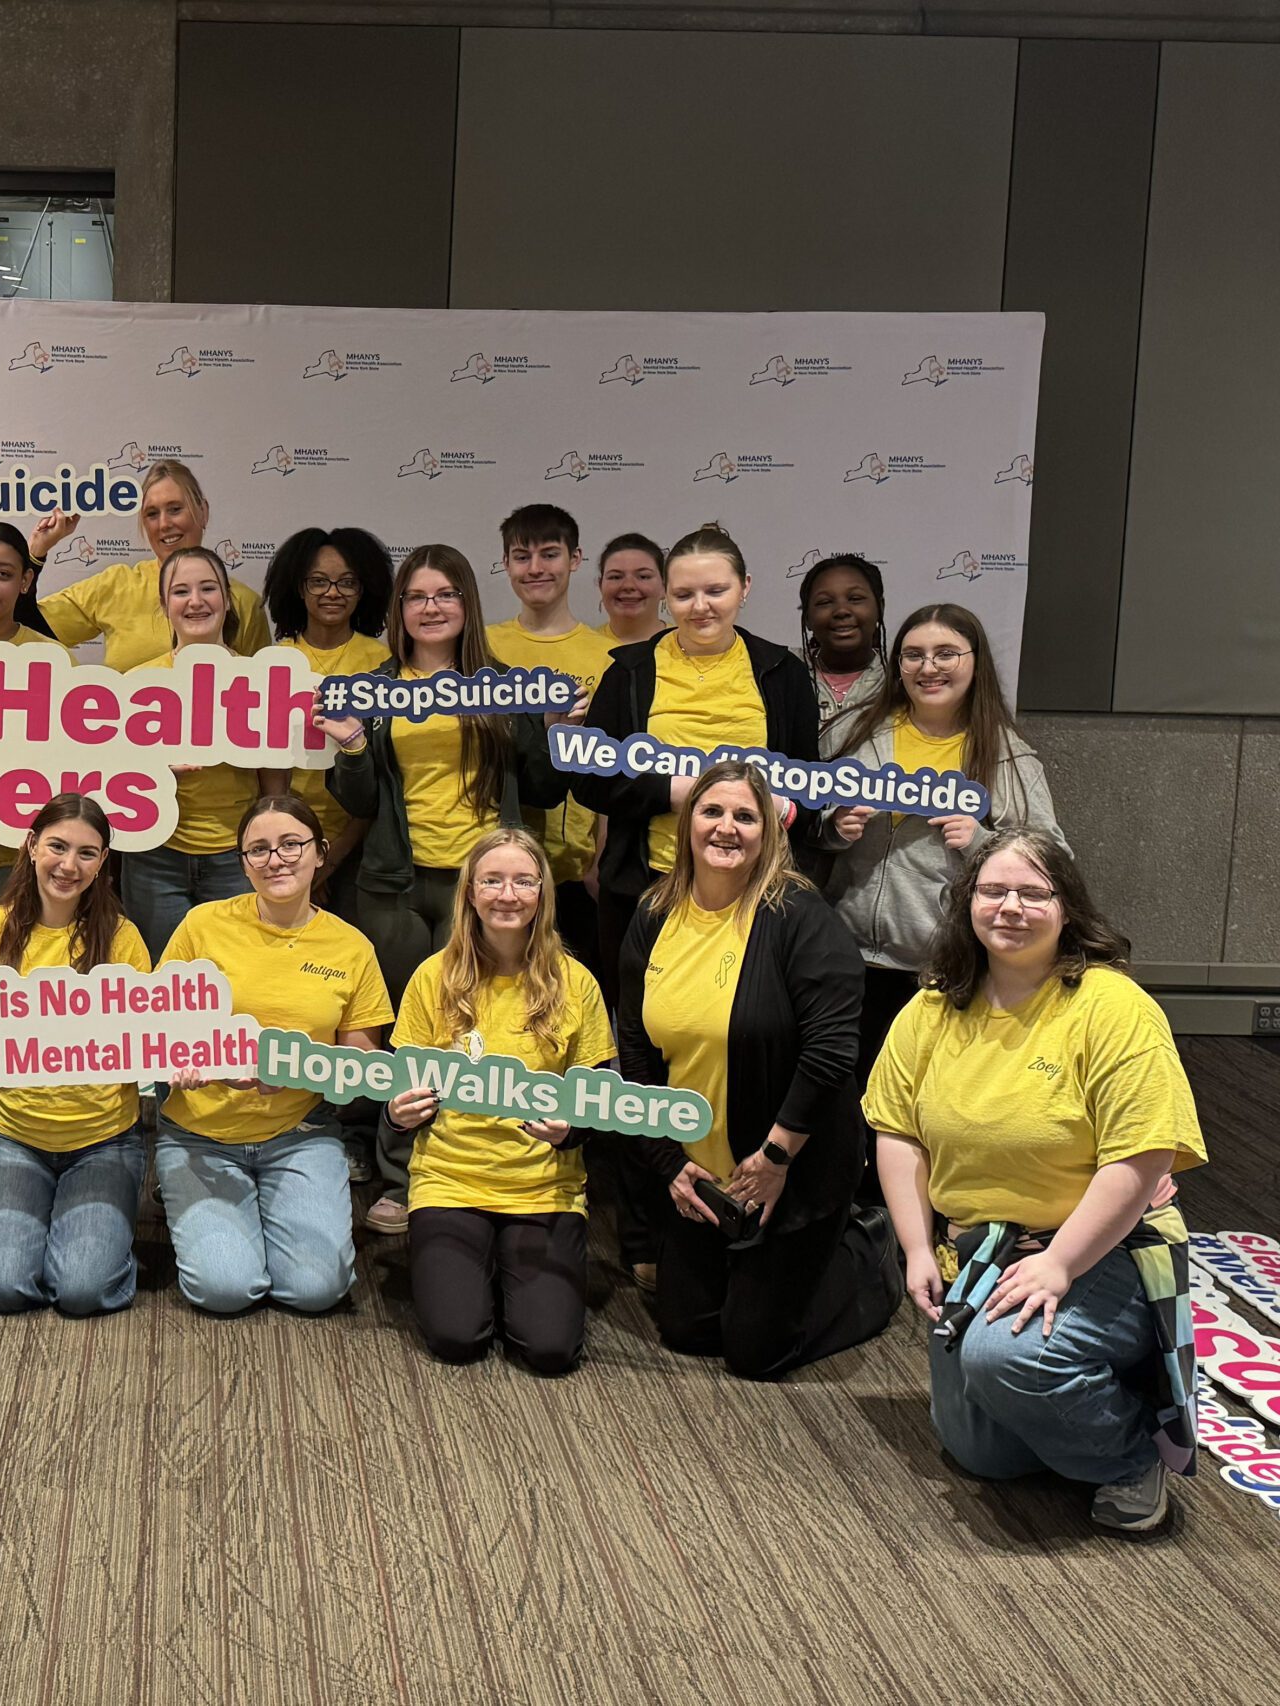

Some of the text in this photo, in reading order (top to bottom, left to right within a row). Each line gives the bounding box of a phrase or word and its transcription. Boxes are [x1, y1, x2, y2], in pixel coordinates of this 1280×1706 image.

[51, 345, 86, 354] MHANYS
[794, 357, 830, 365] MHANYS
[1, 440, 36, 448] MHANYS
[324, 673, 570, 716] #StopSuicide
[557, 731, 982, 813] We Can StopSuicide
[0, 980, 30, 1018] is
[39, 980, 91, 1017] No
[102, 973, 219, 1014] Health
[6, 1031, 131, 1075] Mental
[143, 1028, 259, 1069] Health
[1027, 1056, 1062, 1080] Zoey
[267, 1038, 700, 1132] Hope Walks Here
